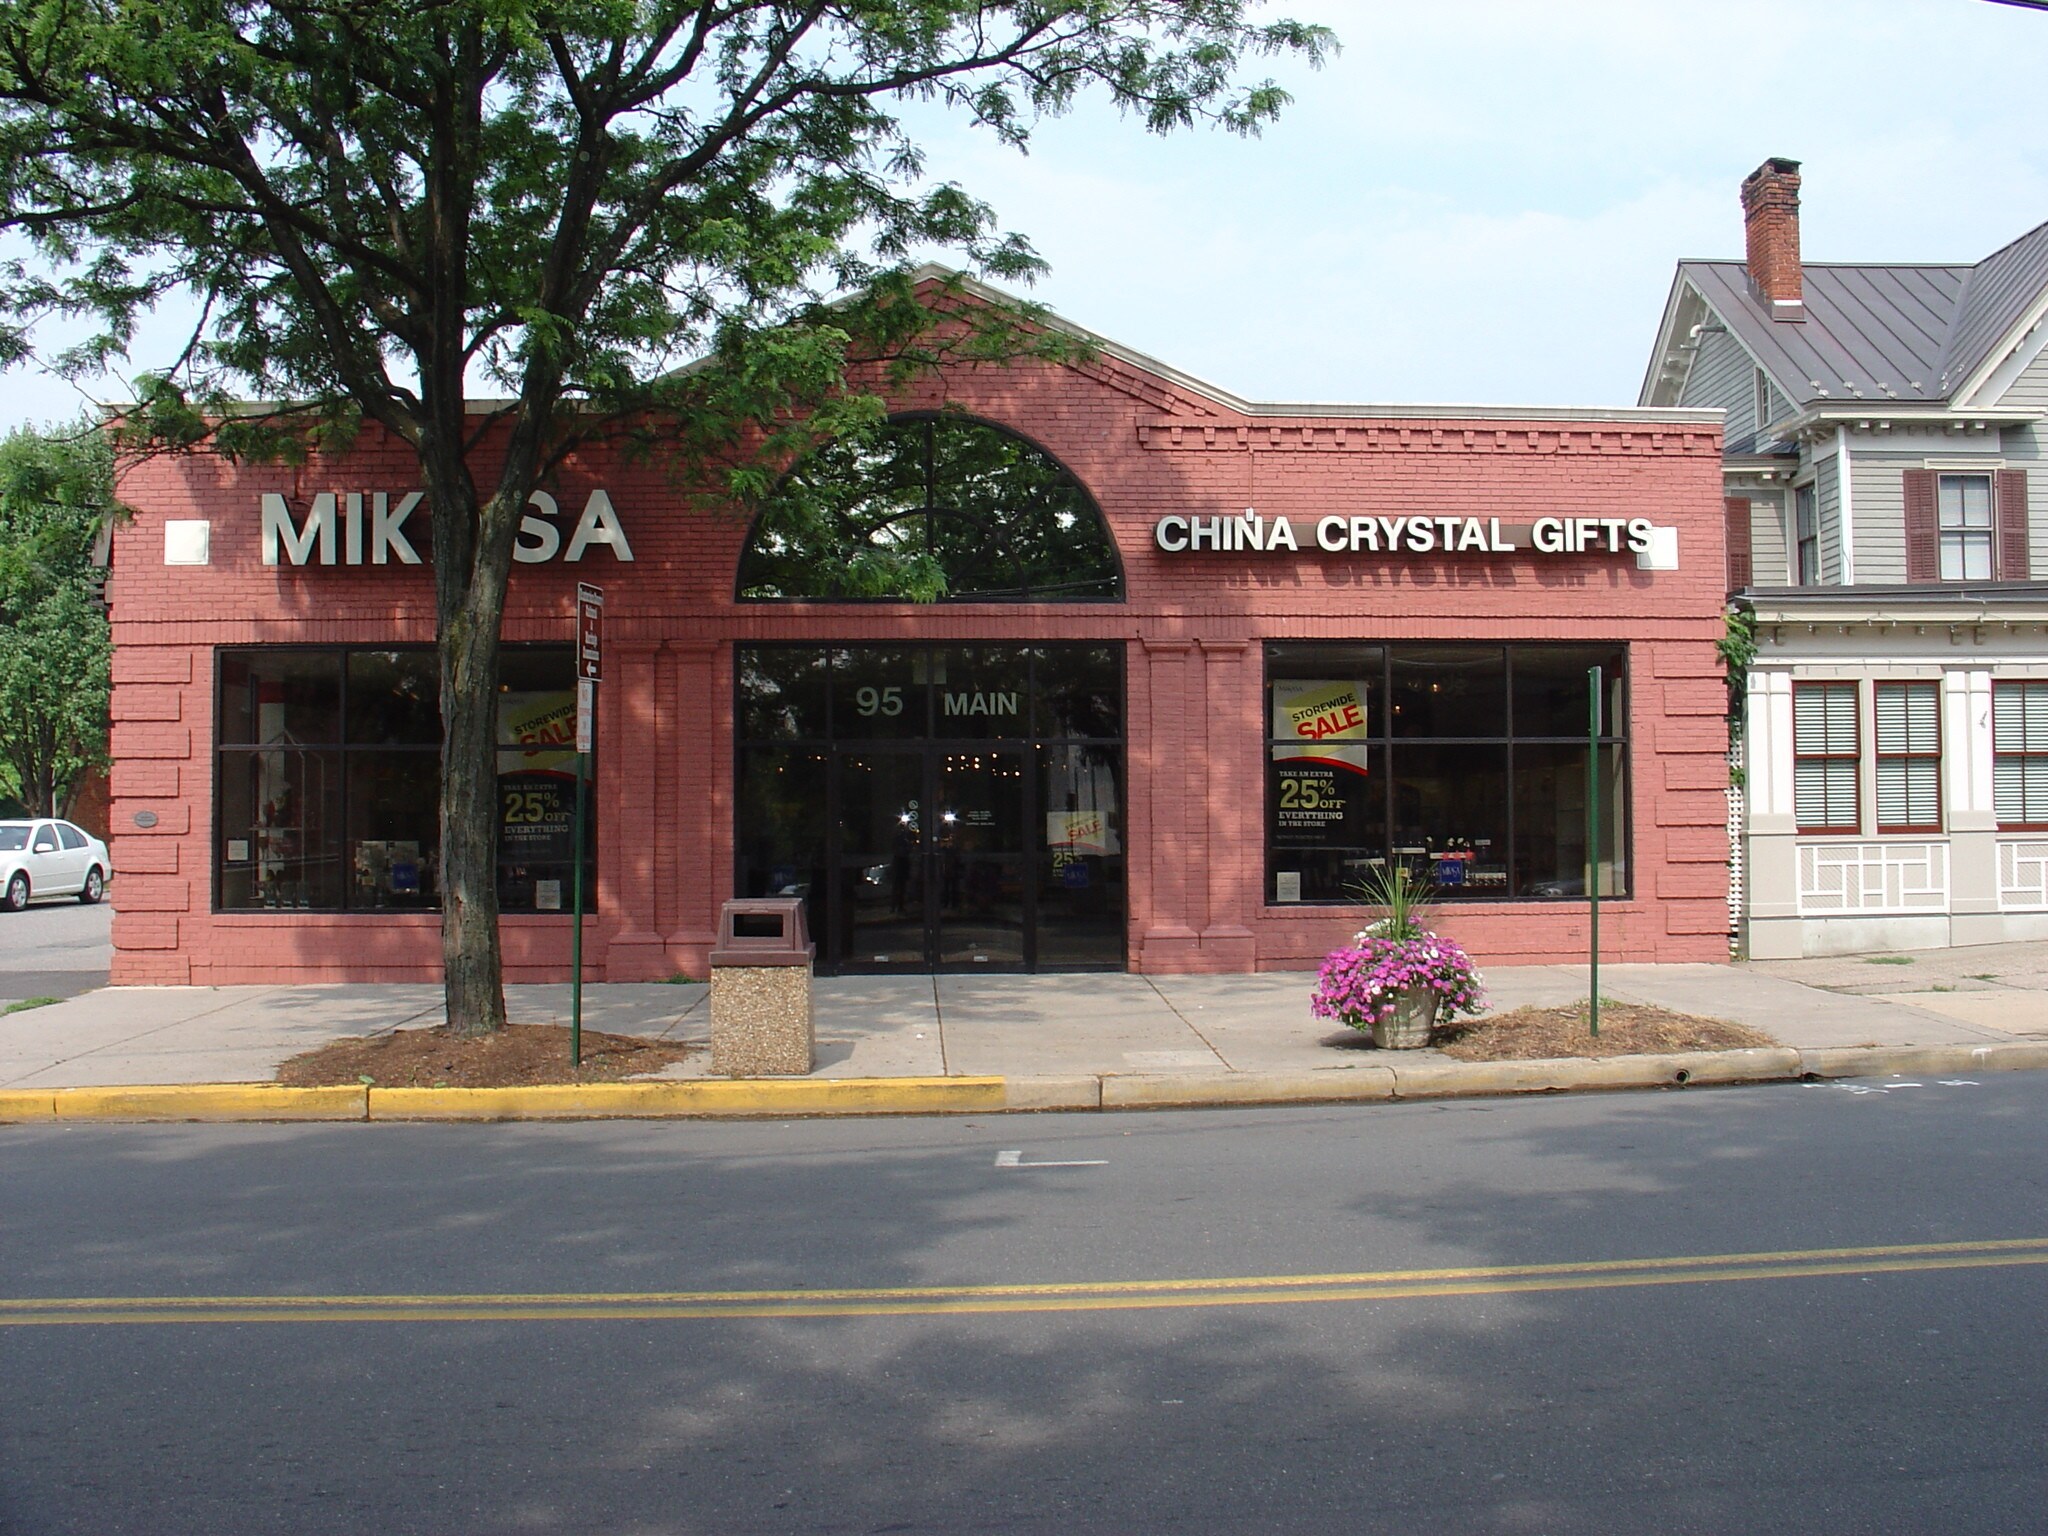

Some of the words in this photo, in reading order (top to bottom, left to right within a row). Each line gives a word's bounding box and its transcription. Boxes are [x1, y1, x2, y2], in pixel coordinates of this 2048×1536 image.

[261, 489, 635, 565] MIKSA
[1156, 515, 1298, 553] CHINA
[1316, 516, 1516, 553] CRYSTAL
[1532, 517, 1655, 553] GIFTS
[856, 687, 903, 716] 95
[944, 692, 1018, 716] MAIN
[1292, 693, 1356, 723] STOREWIDE
[1297, 704, 1364, 740] SALE
[504, 825, 569, 834] EVERYTHING
[1067, 819, 1103, 840] SALE
[1278, 811, 1344, 820] EVERYTHING
